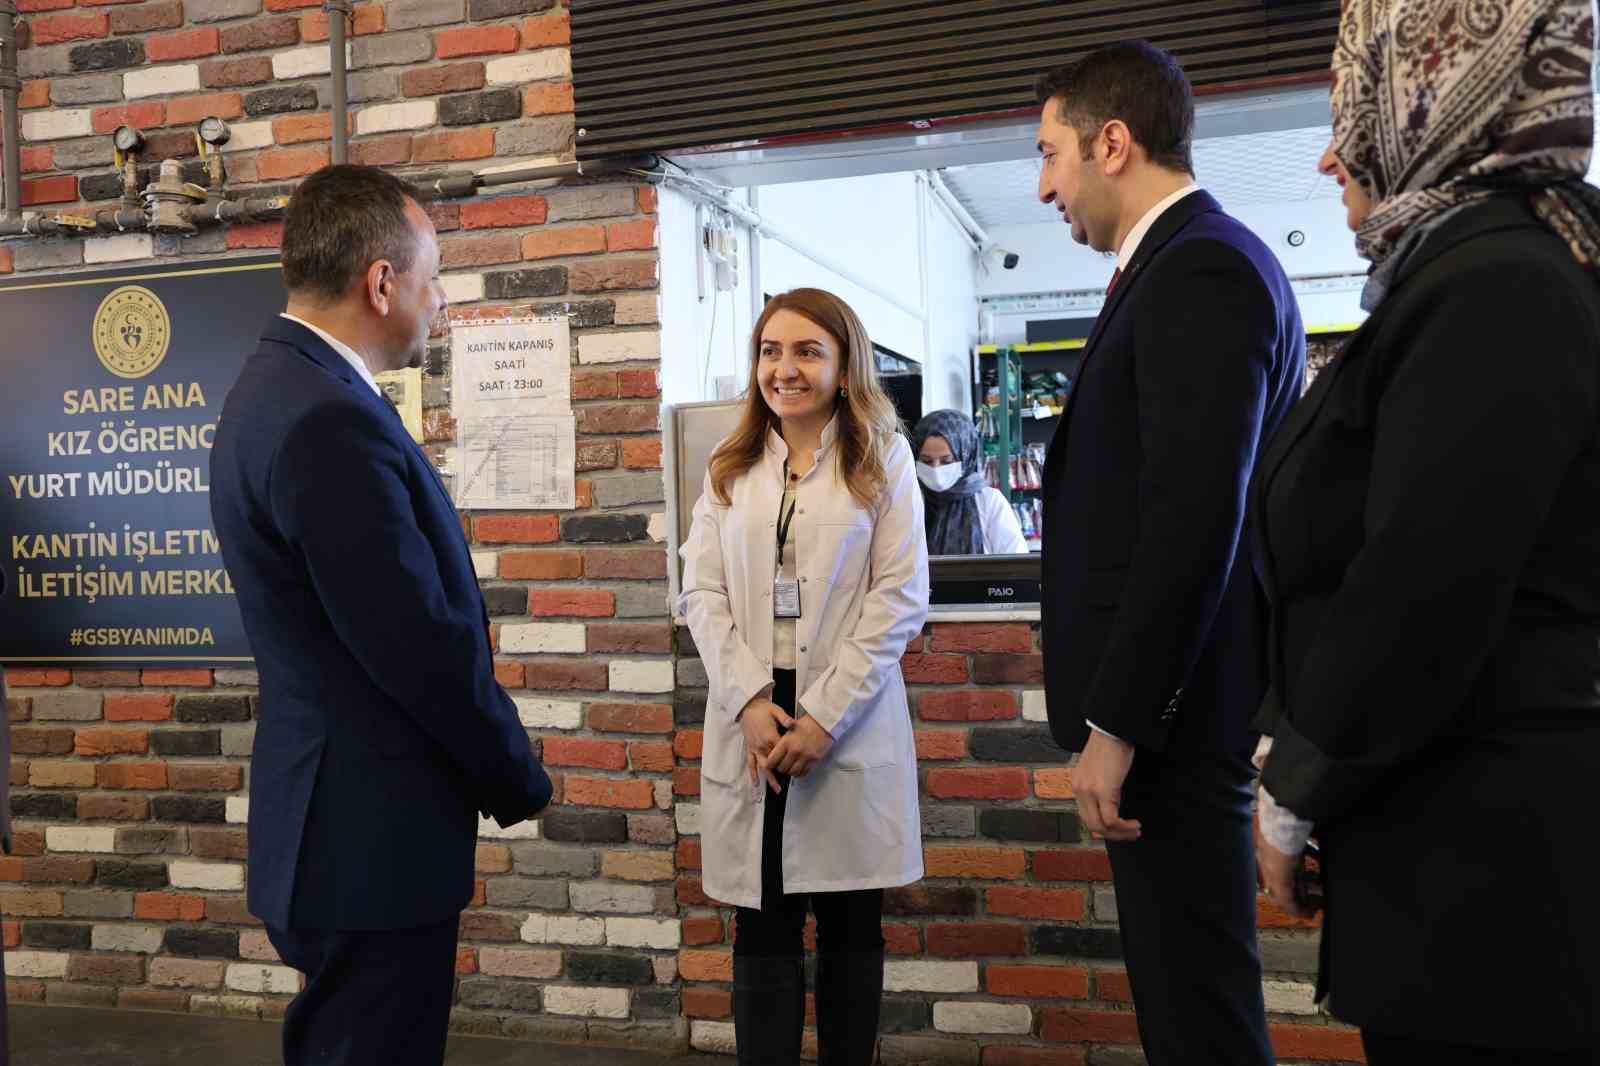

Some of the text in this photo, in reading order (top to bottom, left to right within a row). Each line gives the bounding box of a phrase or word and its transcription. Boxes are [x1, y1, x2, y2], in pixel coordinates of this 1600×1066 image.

[467, 338, 554, 353] KANTİN KAPANIŞ
[494, 358, 526, 370] SAATİ
[63, 382, 207, 415] SARE ANA
[479, 380, 505, 391] SAAT
[513, 379, 543, 390] 23:00
[48, 417, 221, 457] KIZ ÖĞRENC
[8, 460, 210, 499] YURT MÜDÜRL
[12, 521, 117, 560] KANTİN
[17, 563, 134, 604] İLETİŞİM
[69, 627, 215, 647] #GSBYANIMDA
